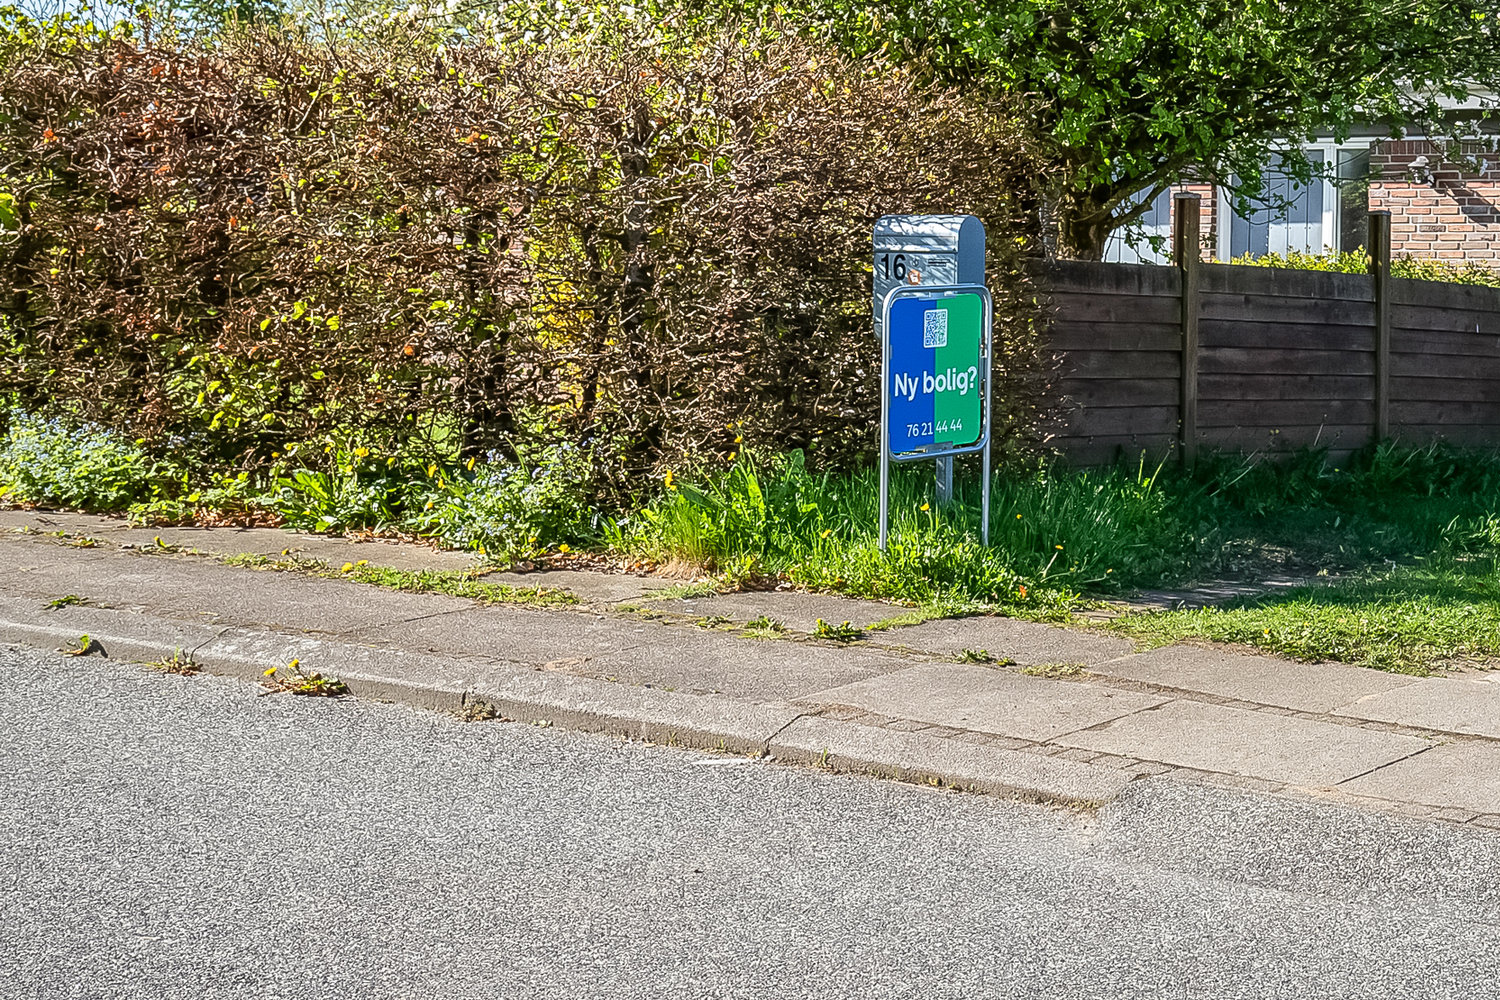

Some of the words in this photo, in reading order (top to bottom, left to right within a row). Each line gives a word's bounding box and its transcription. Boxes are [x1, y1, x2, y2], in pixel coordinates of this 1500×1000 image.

[880, 253, 907, 281] 16
[894, 372, 919, 402] Ny
[923, 366, 978, 396] bolig?
[906, 423, 920, 438] 76
[921, 422, 934, 436] 21
[935, 420, 948, 434] 44
[950, 418, 963, 431] 44
